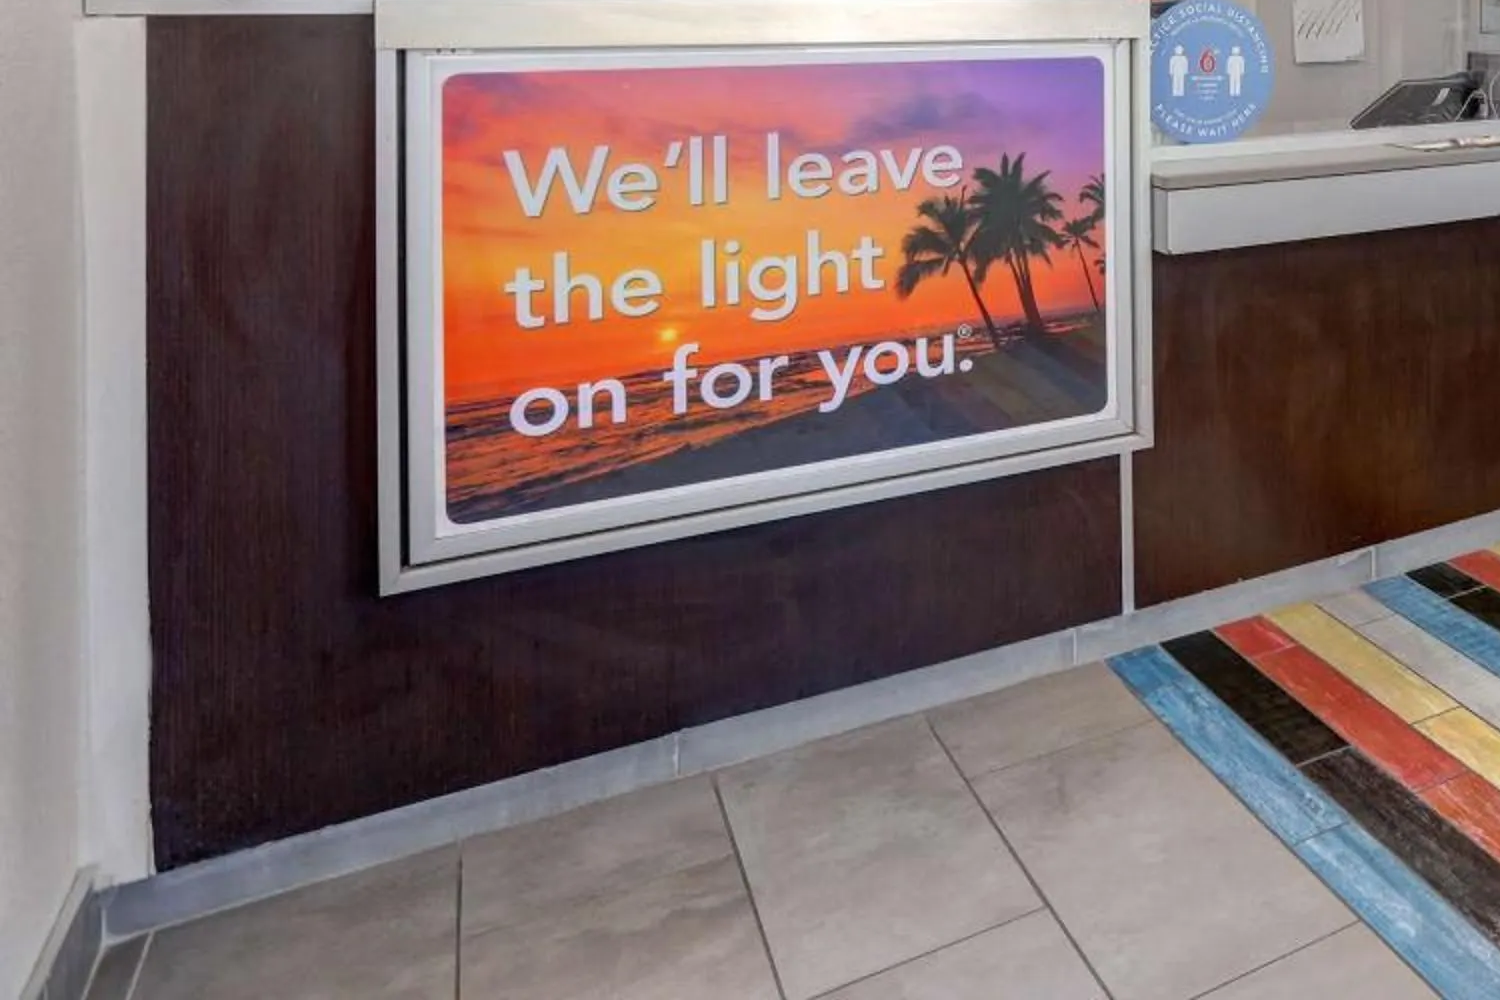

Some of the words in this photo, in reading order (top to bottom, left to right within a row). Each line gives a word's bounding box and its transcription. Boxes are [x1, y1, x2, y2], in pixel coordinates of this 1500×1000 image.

[1180, 2, 1221, 19] SOCIAL
[1226, 7, 1269, 74] DISTANCING
[1154, 103, 1193, 135] PLEASE
[1197, 124, 1228, 137] WAIT
[1230, 103, 1257, 129] HERE
[503, 134, 727, 218] We'll
[766, 131, 964, 200] leave
[504, 251, 664, 329] the
[700, 230, 885, 321] light
[508, 375, 627, 437] on
[663, 343, 790, 415] for
